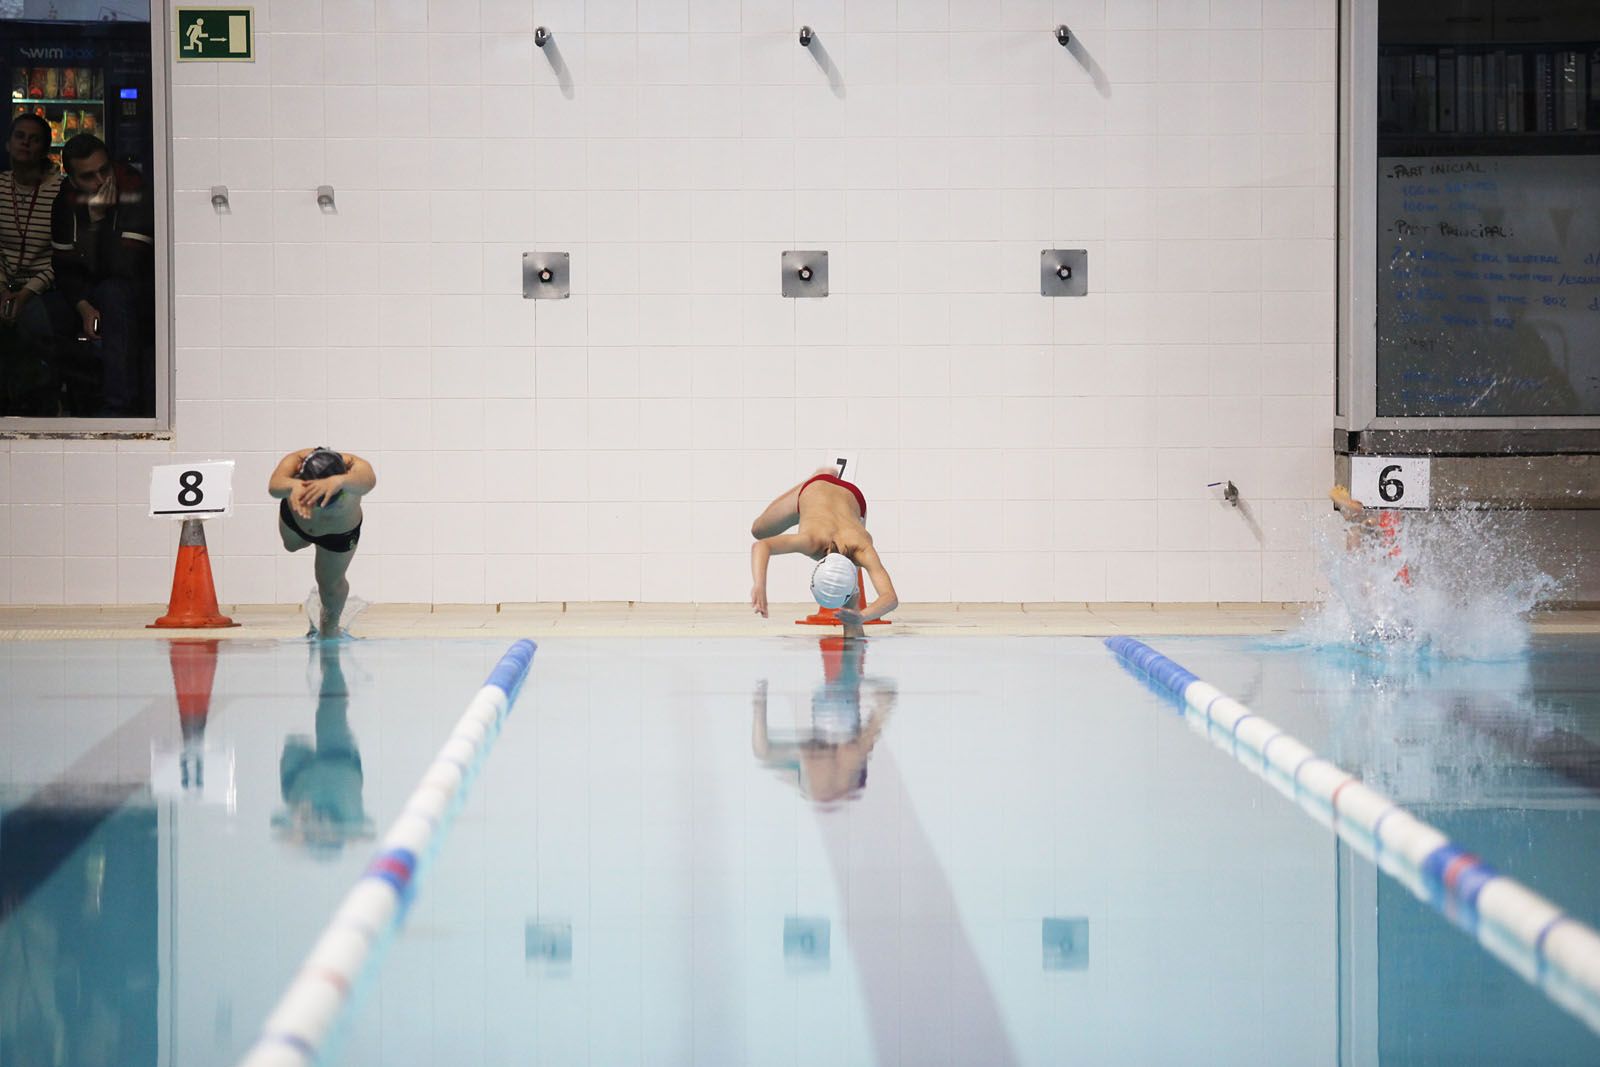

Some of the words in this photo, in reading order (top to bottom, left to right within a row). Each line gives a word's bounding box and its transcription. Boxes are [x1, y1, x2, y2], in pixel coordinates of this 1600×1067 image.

[836, 458, 847, 479] 7
[1379, 465, 1404, 503] 6
[178, 470, 203, 507] 8
